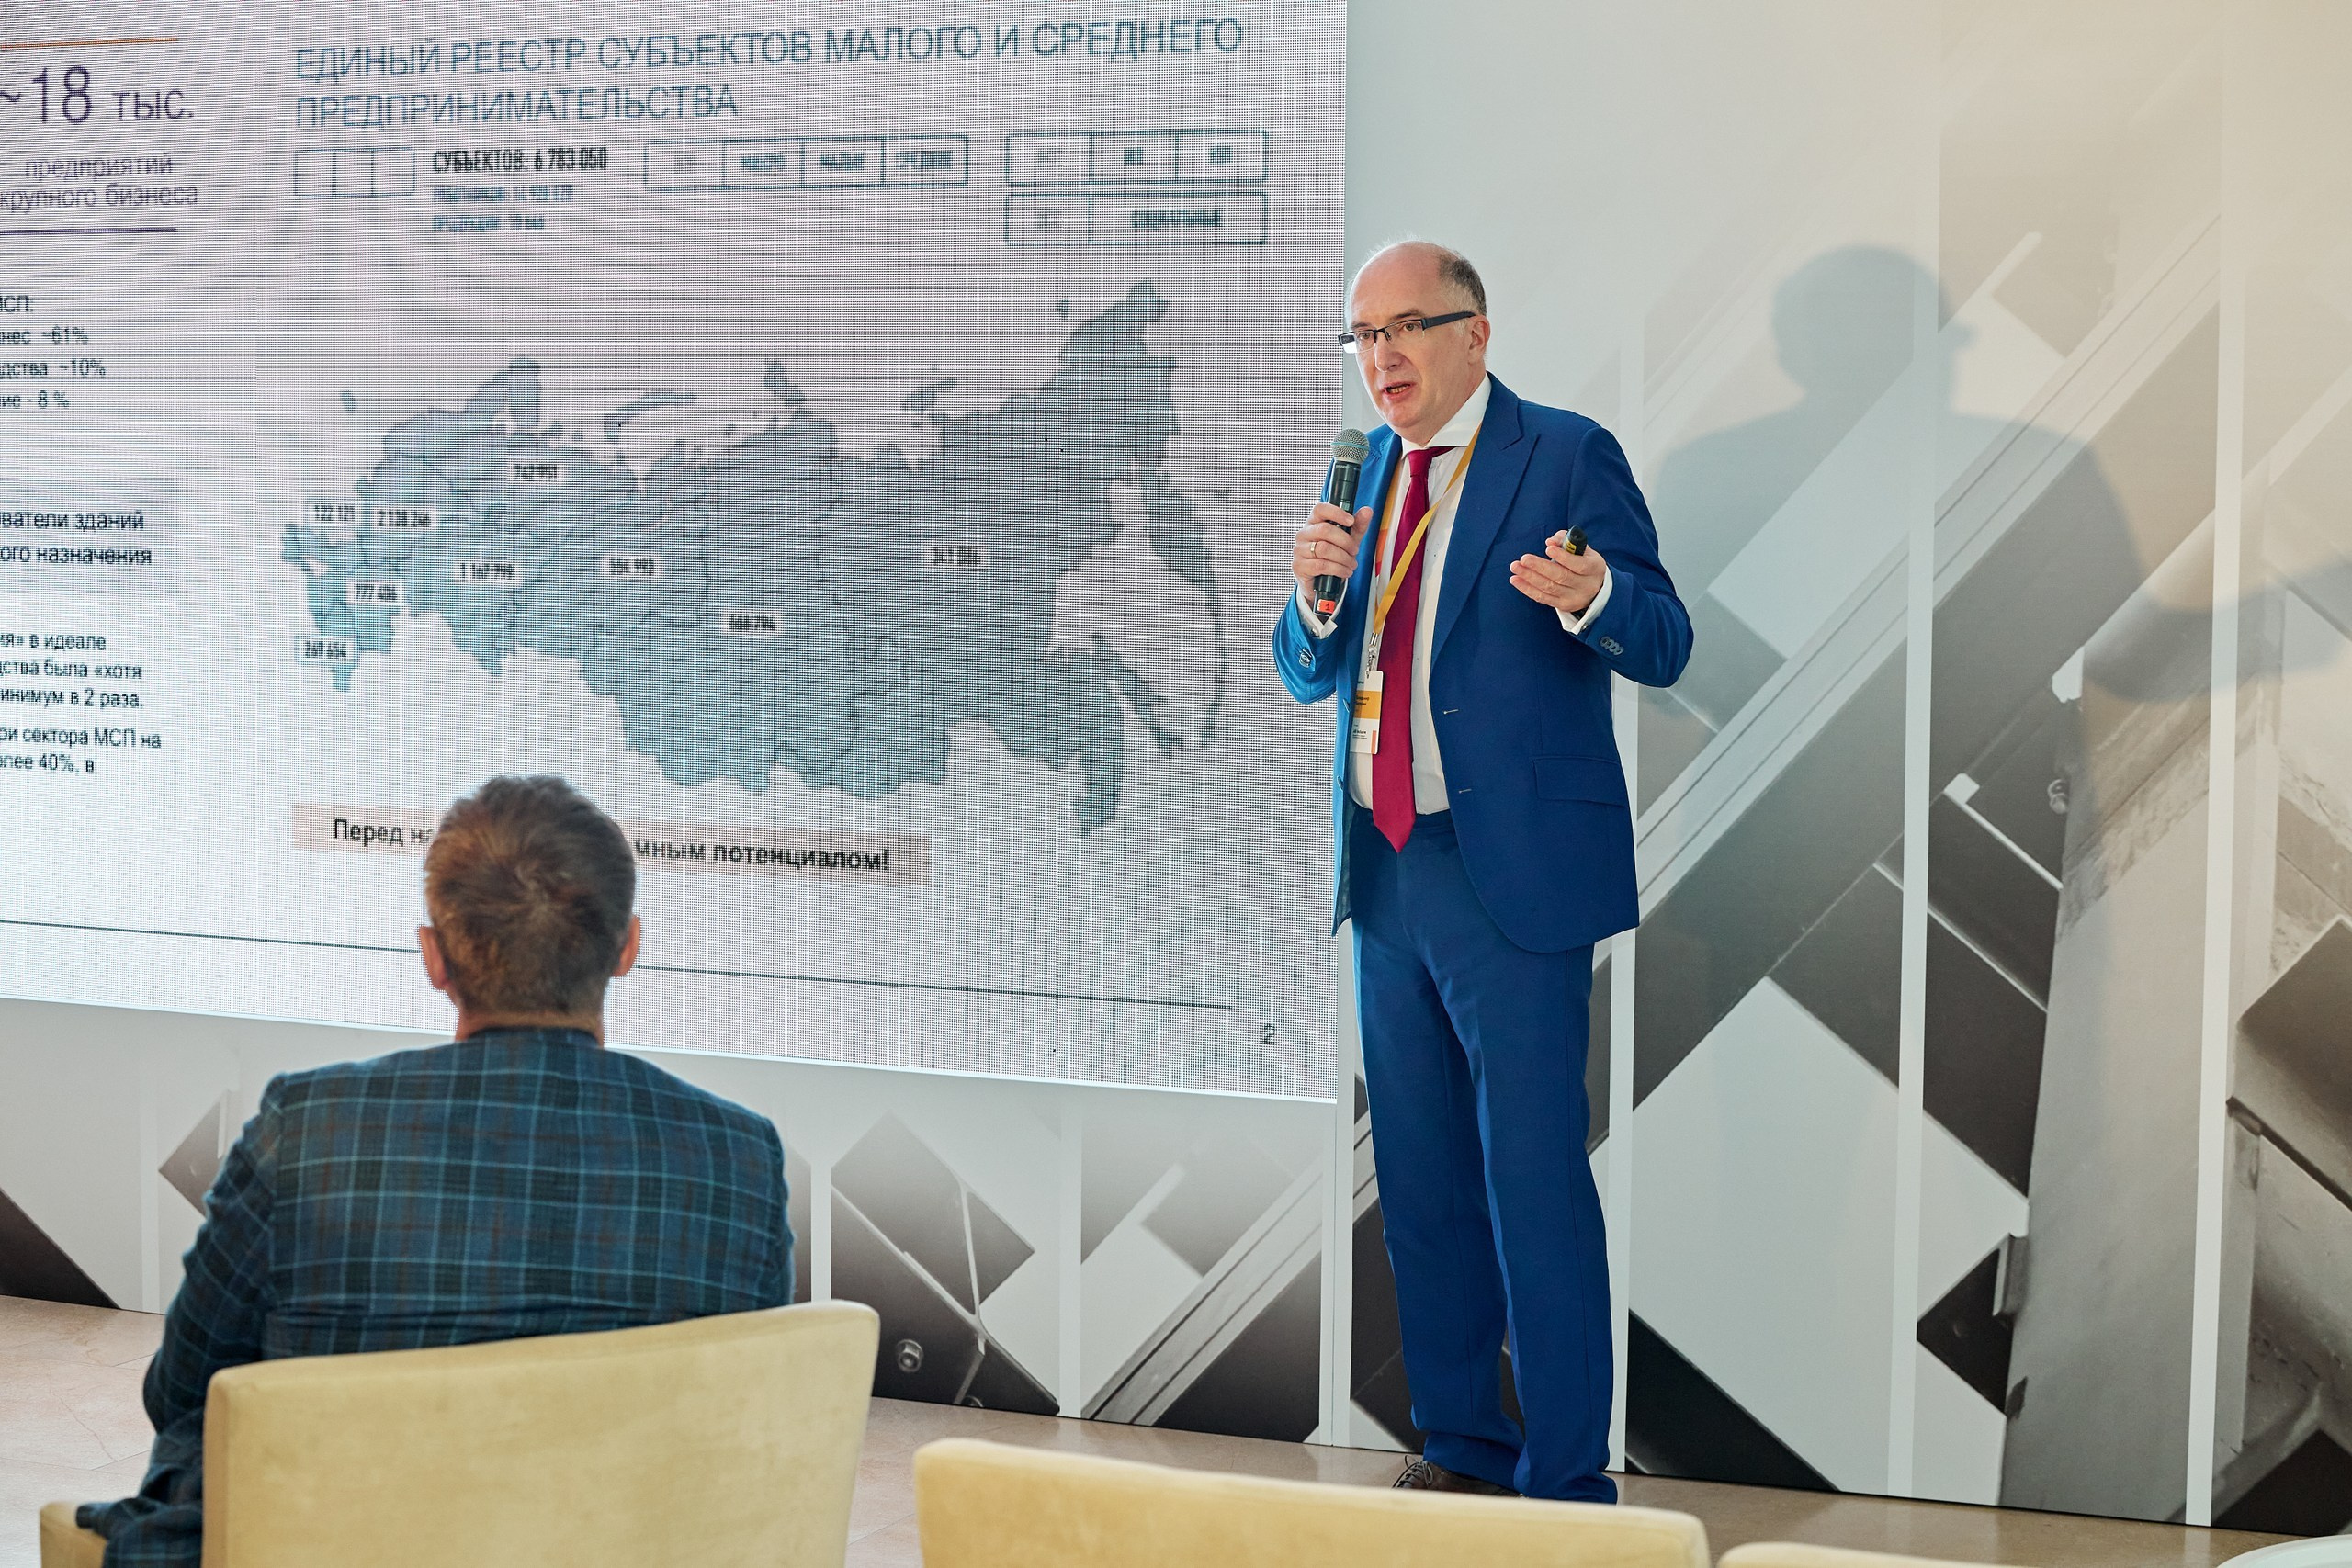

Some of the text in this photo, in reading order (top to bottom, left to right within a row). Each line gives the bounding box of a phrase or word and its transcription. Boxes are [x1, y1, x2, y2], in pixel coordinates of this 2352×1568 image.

[297, 18, 1243, 83] ЕДИНЫЙ РЕЕСТР СУБЪЕКТОВ МАЛОГО И СРЕДНЕГО
[297, 84, 738, 131] ПРЕДПРИНИМАТЕЛЬСТВА
[25, 152, 174, 179] предприятий
[433, 146, 607, 174] СУБЪЕКТОВ: 6 783 050
[0, 184, 198, 214] крупного бизнеса
[0, 330, 30, 344] нес
[0, 394, 21, 408] ие
[0, 509, 143, 532] ватели зданий
[37, 547, 152, 565] назначения
[29, 634, 39, 649] в
[44, 634, 106, 651] идеале
[44, 656, 88, 678] была
[0, 688, 143, 710] инимум в 2 раза.
[23, 728, 88, 749] сектора
[94, 728, 136, 747] МСП
[141, 734, 161, 749] на
[85, 759, 94, 773] в
[334, 819, 404, 847] Перед
[714, 843, 888, 871] потенциалом!
[1262, 1023, 1276, 1045] 2
